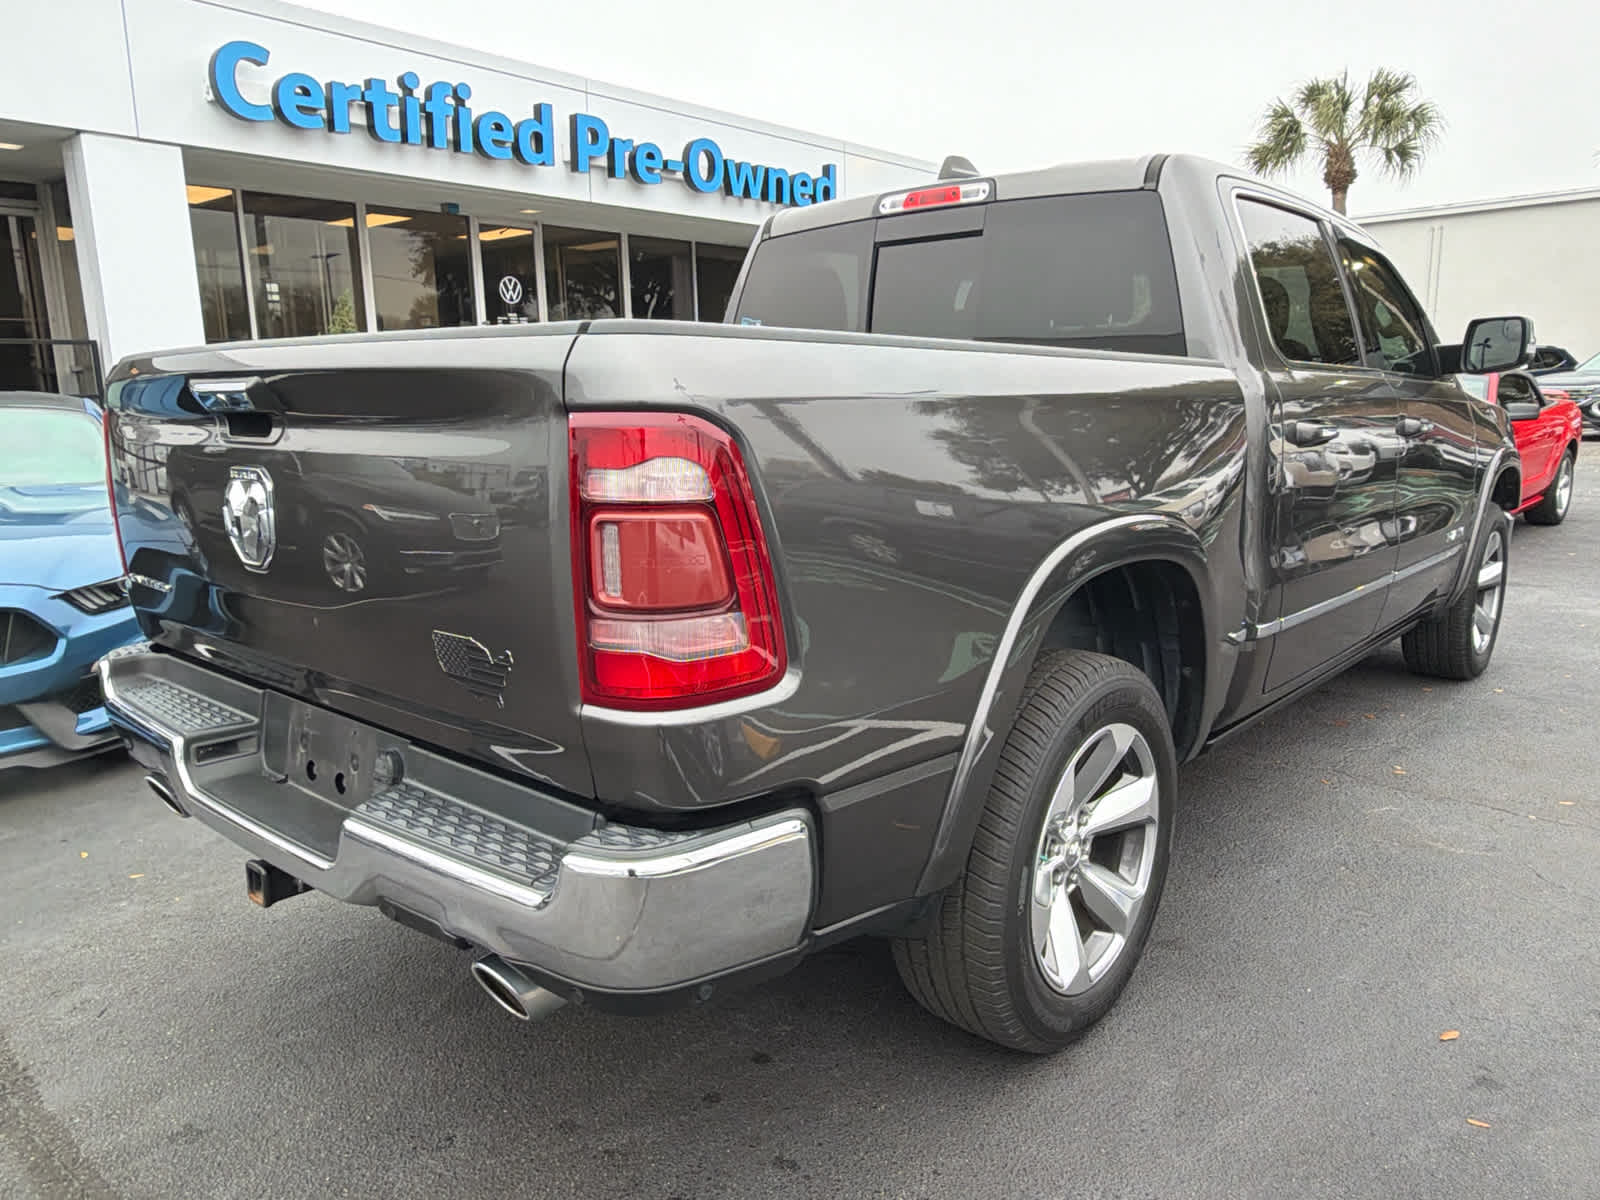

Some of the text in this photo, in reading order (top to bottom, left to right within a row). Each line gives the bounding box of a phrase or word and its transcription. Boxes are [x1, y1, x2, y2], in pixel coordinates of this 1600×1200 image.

[210, 40, 836, 207] Certified Pre-Owned
[499, 276, 522, 304] VW
